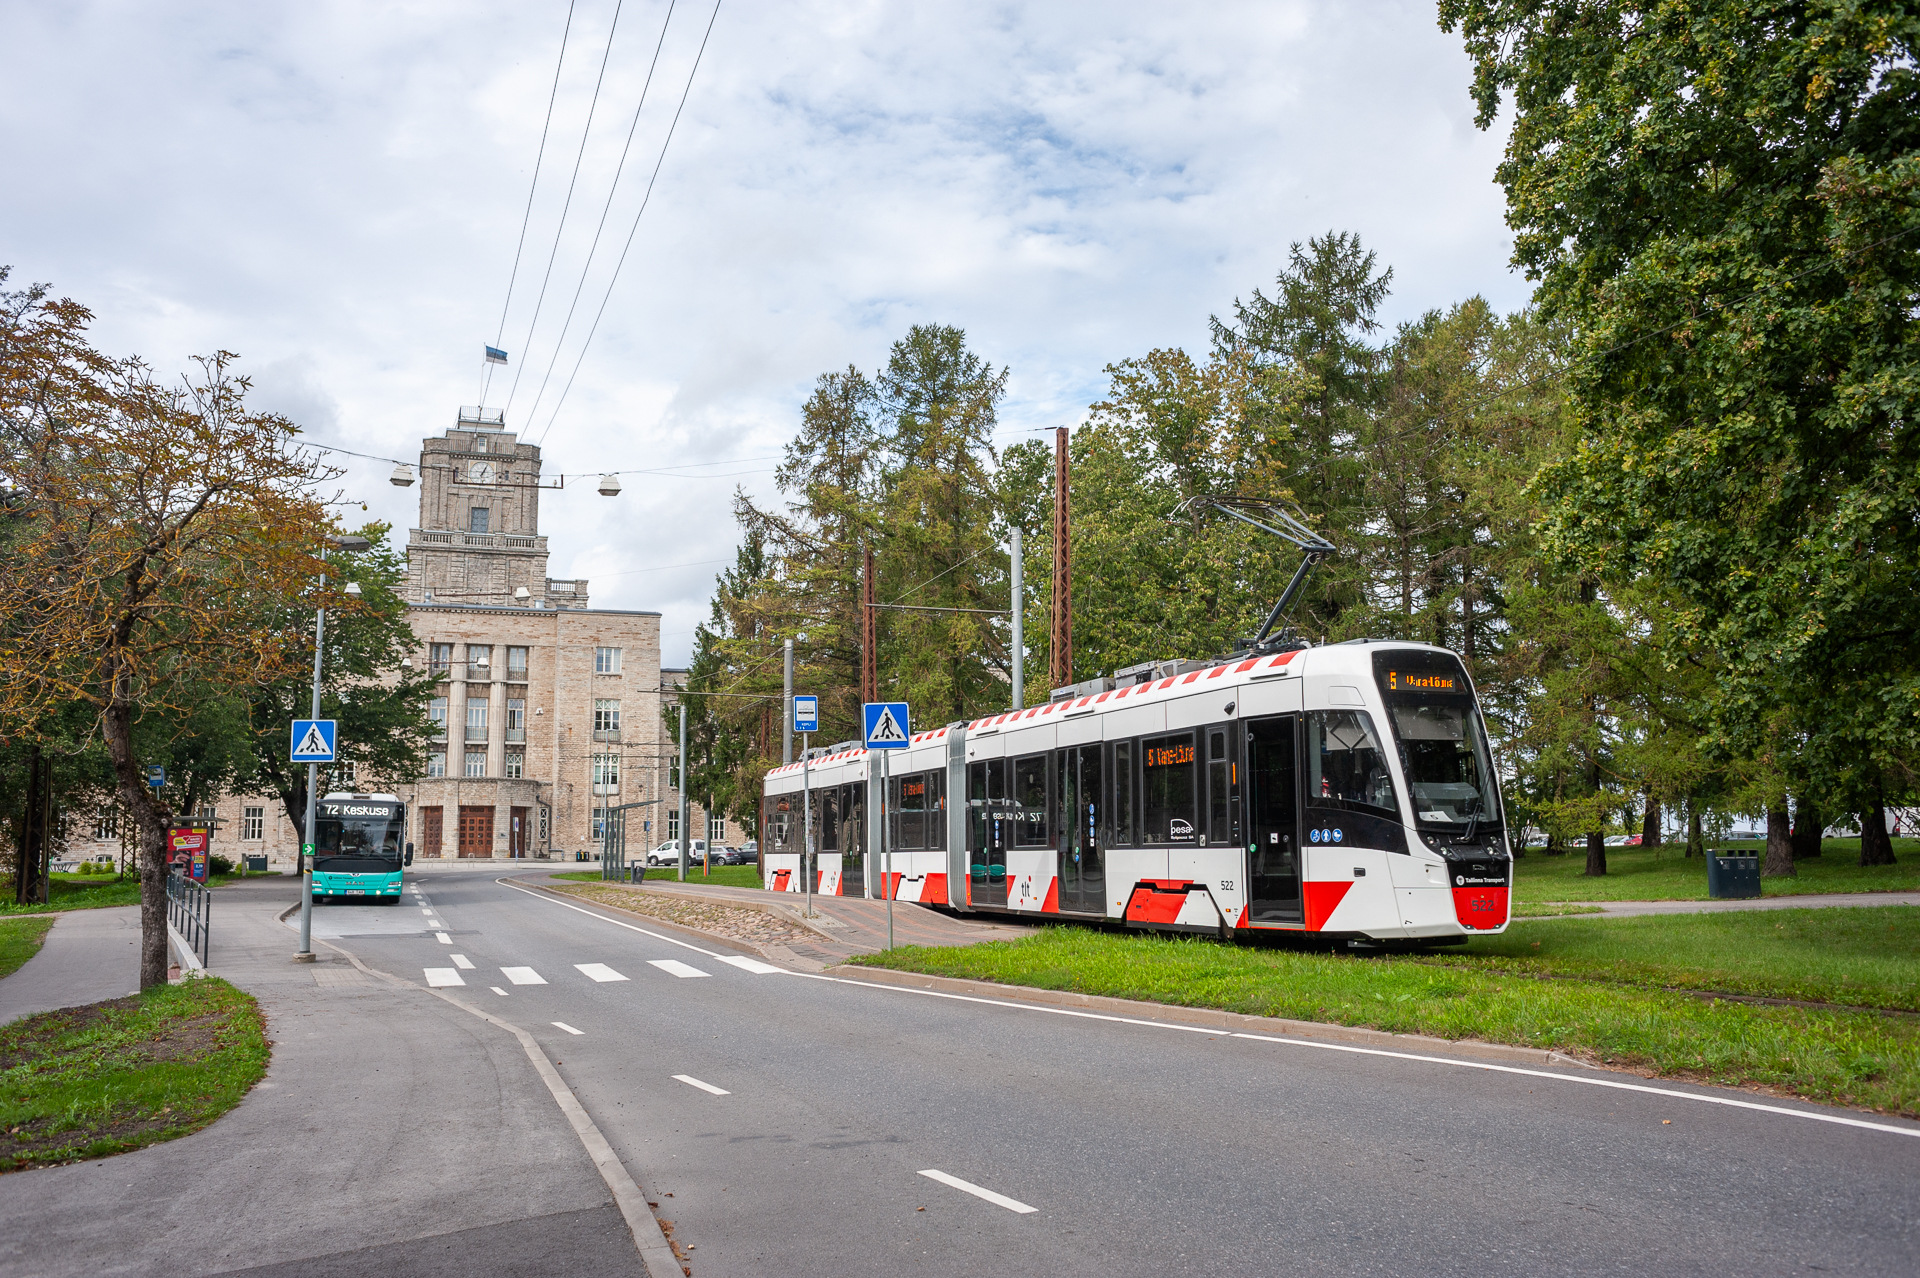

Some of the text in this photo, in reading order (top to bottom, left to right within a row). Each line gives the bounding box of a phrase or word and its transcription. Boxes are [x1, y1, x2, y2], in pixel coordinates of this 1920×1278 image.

[325, 804, 389, 816] 72 Keskuse
[1220, 880, 1235, 891] 522
[1465, 876, 1505, 884] Tallinna Transport
[1471, 899, 1495, 912] 522
